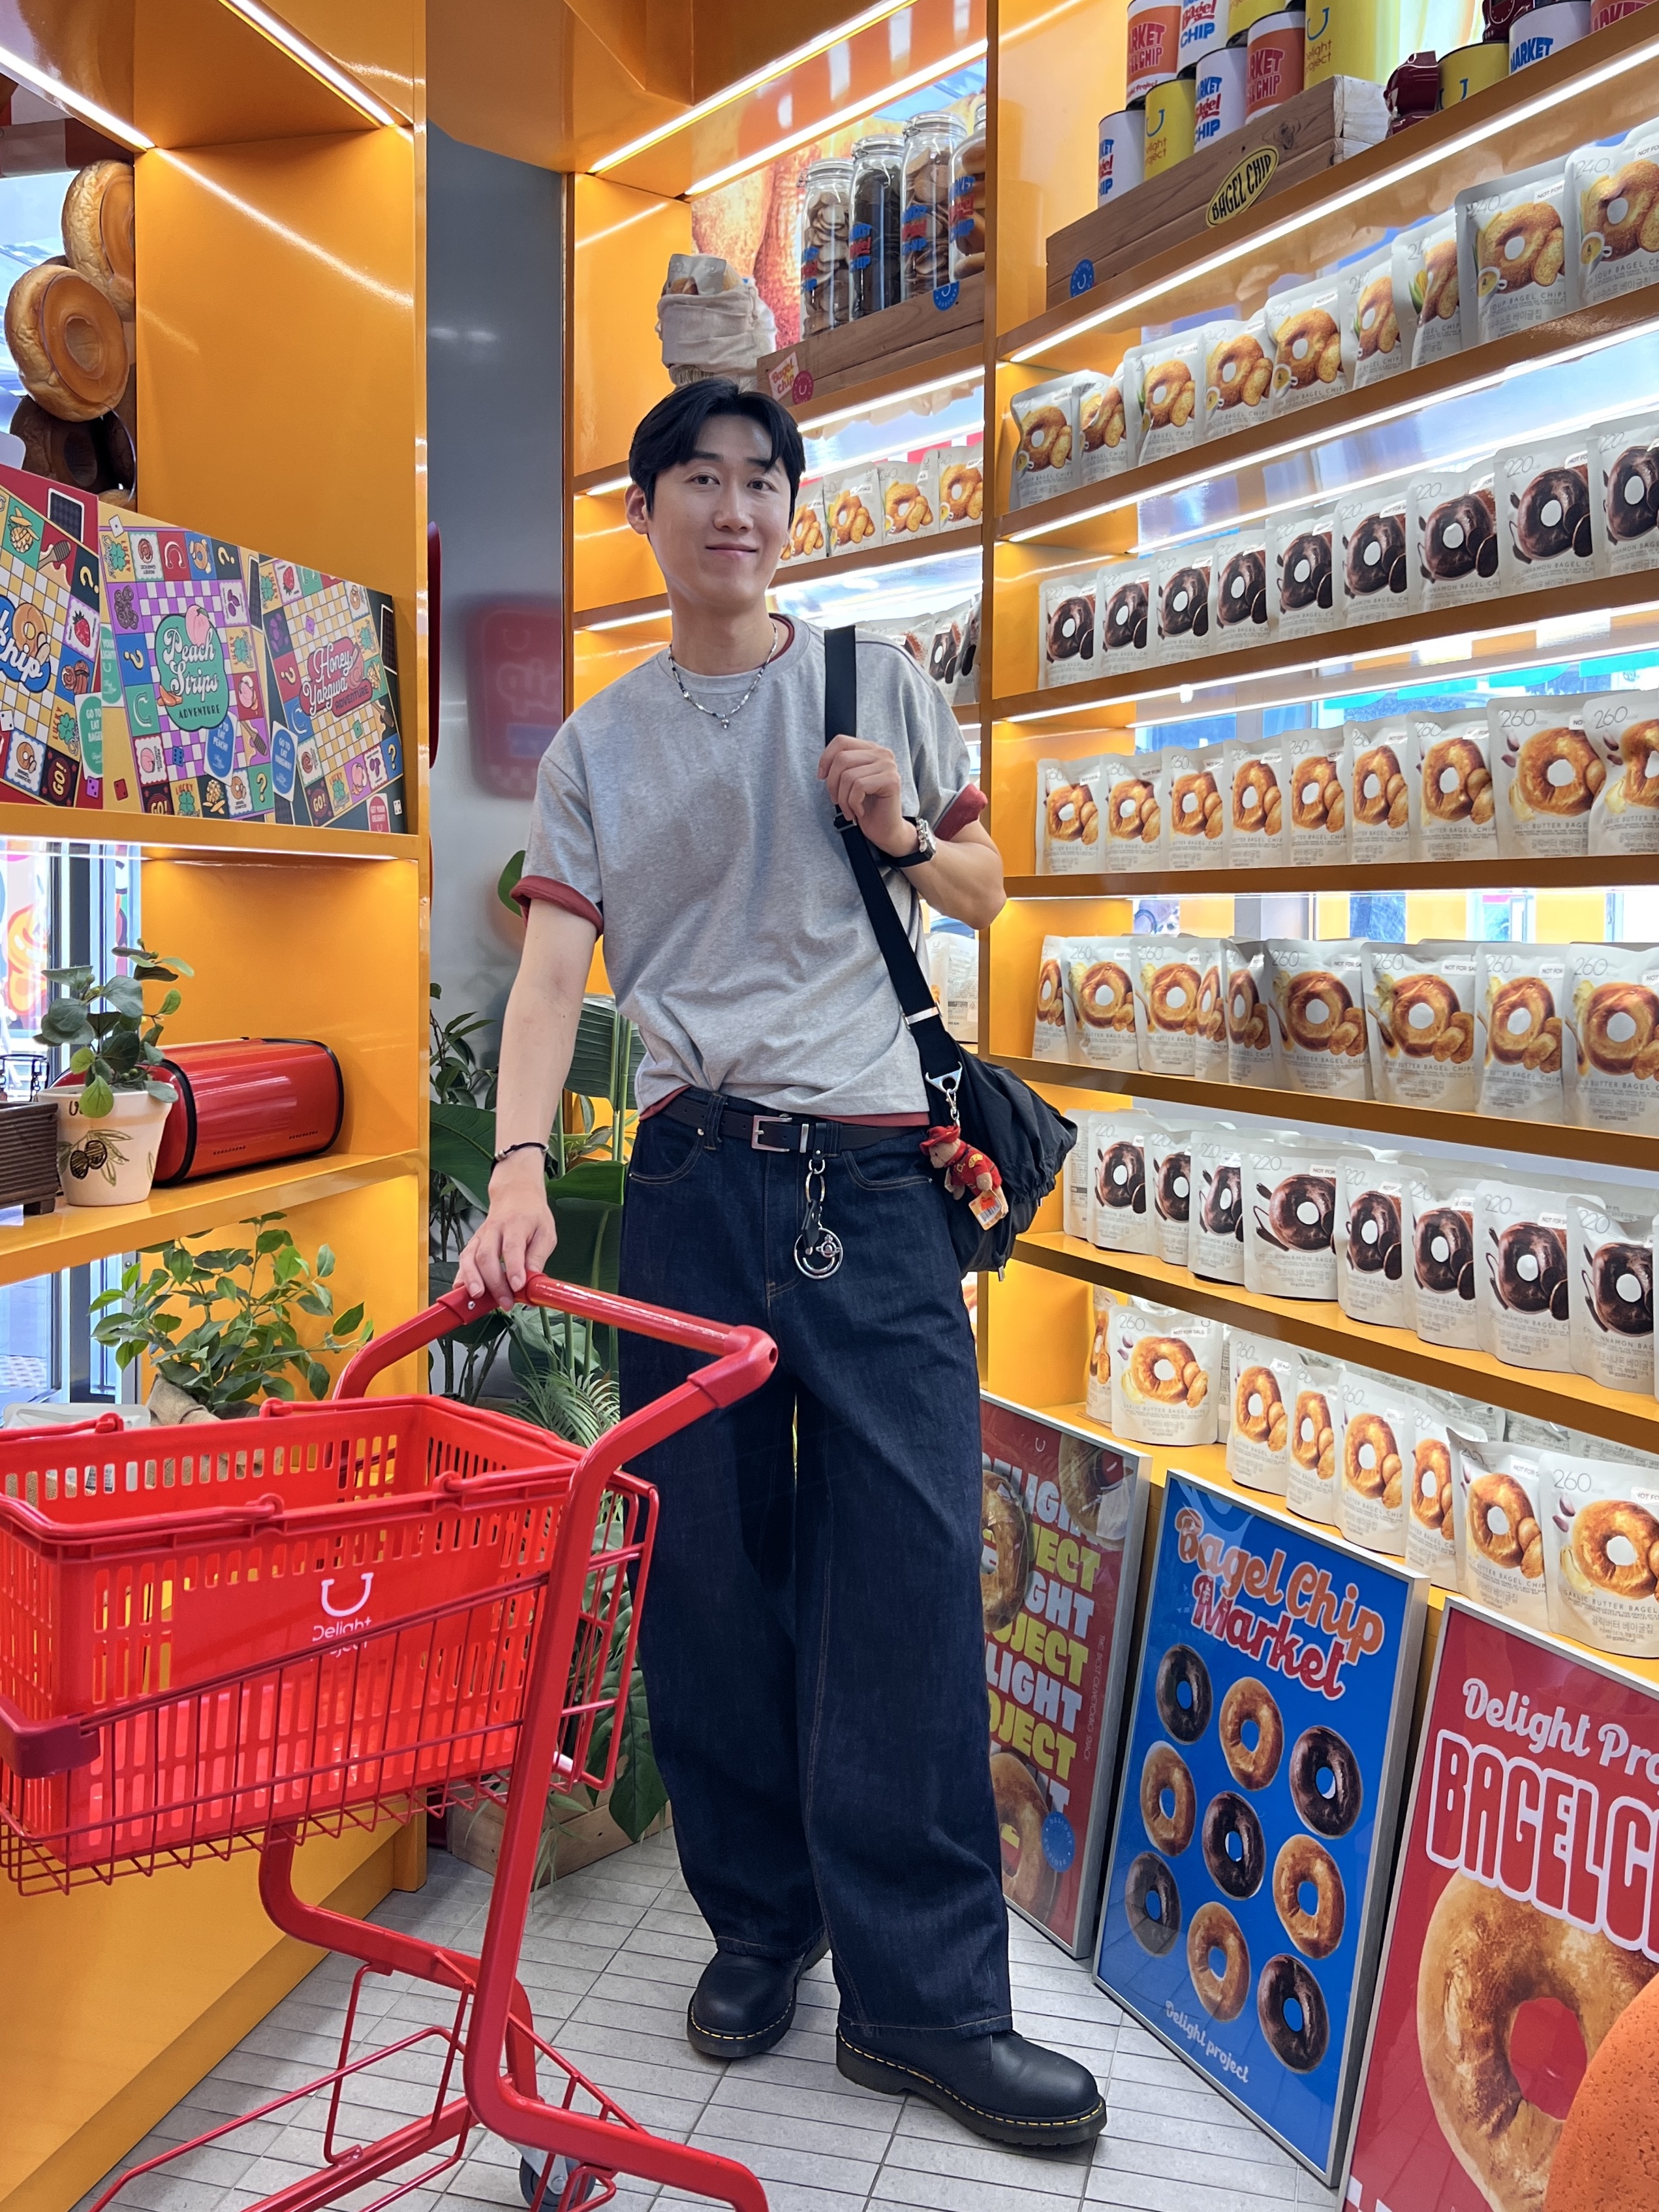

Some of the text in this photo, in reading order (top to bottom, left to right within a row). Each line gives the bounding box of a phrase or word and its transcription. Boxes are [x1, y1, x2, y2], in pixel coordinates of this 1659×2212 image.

[1181, 22, 1215, 48] CHIP
[1575, 157, 1611, 181] 240
[1212, 154, 1272, 221] BAGEL CHIP
[1615, 260, 1645, 273] BAGEL
[1506, 456, 1535, 478] 220
[1416, 482, 1442, 502] 220
[1554, 560, 1581, 569] BAGEL
[163, 627, 215, 664] Peach
[313, 642, 354, 683] Honey
[169, 660, 219, 703] Strips
[302, 676, 348, 716] Yakgwa
[335, 685, 369, 710] ADVENTURE
[178, 704, 221, 719] ADVENTURE
[1500, 708, 1536, 728] 260
[1594, 706, 1628, 730] 260
[52, 706, 63, 741] LUCKY
[53, 761, 67, 796] GO!
[313, 793, 327, 812] GO!
[1070, 946, 1093, 961] 260
[1271, 949, 1300, 968] 260
[1374, 952, 1404, 971] 260
[1485, 955, 1513, 973] 260
[1574, 957, 1608, 976] 260
[1320, 1056, 1344, 1065] BAGEL
[1423, 1063, 1446, 1072] BAGEL
[1512, 1071, 1536, 1081] BAGEL
[1622, 1082, 1651, 1091] BAGEL
[1252, 1155, 1282, 1171] 220
[1484, 1194, 1513, 1215] 220
[1577, 1209, 1611, 1234] 220
[1119, 1315, 1145, 1332] 260
[1532, 1320, 1558, 1330] BAGEL
[1342, 1384, 1365, 1406] 260
[1513, 1464, 1524, 1473] NOT
[1553, 1469, 1592, 1493] 260
[1175, 1506, 1385, 1666] Bagel Chip
[1499, 1572, 1524, 1585] BAGEL
[1563, 1587, 1589, 1603] GARLIC
[1592, 1597, 1624, 1611] BUTTER
[1628, 1603, 1658, 1614] BAGEL
[1191, 1573, 1346, 1701] Market
[984, 1640, 1083, 1734] LIGHT
[1462, 1677, 1591, 1758] Delight
[987, 1689, 1078, 1781] OJECT
[1165, 1999, 1249, 2083] Delight project
